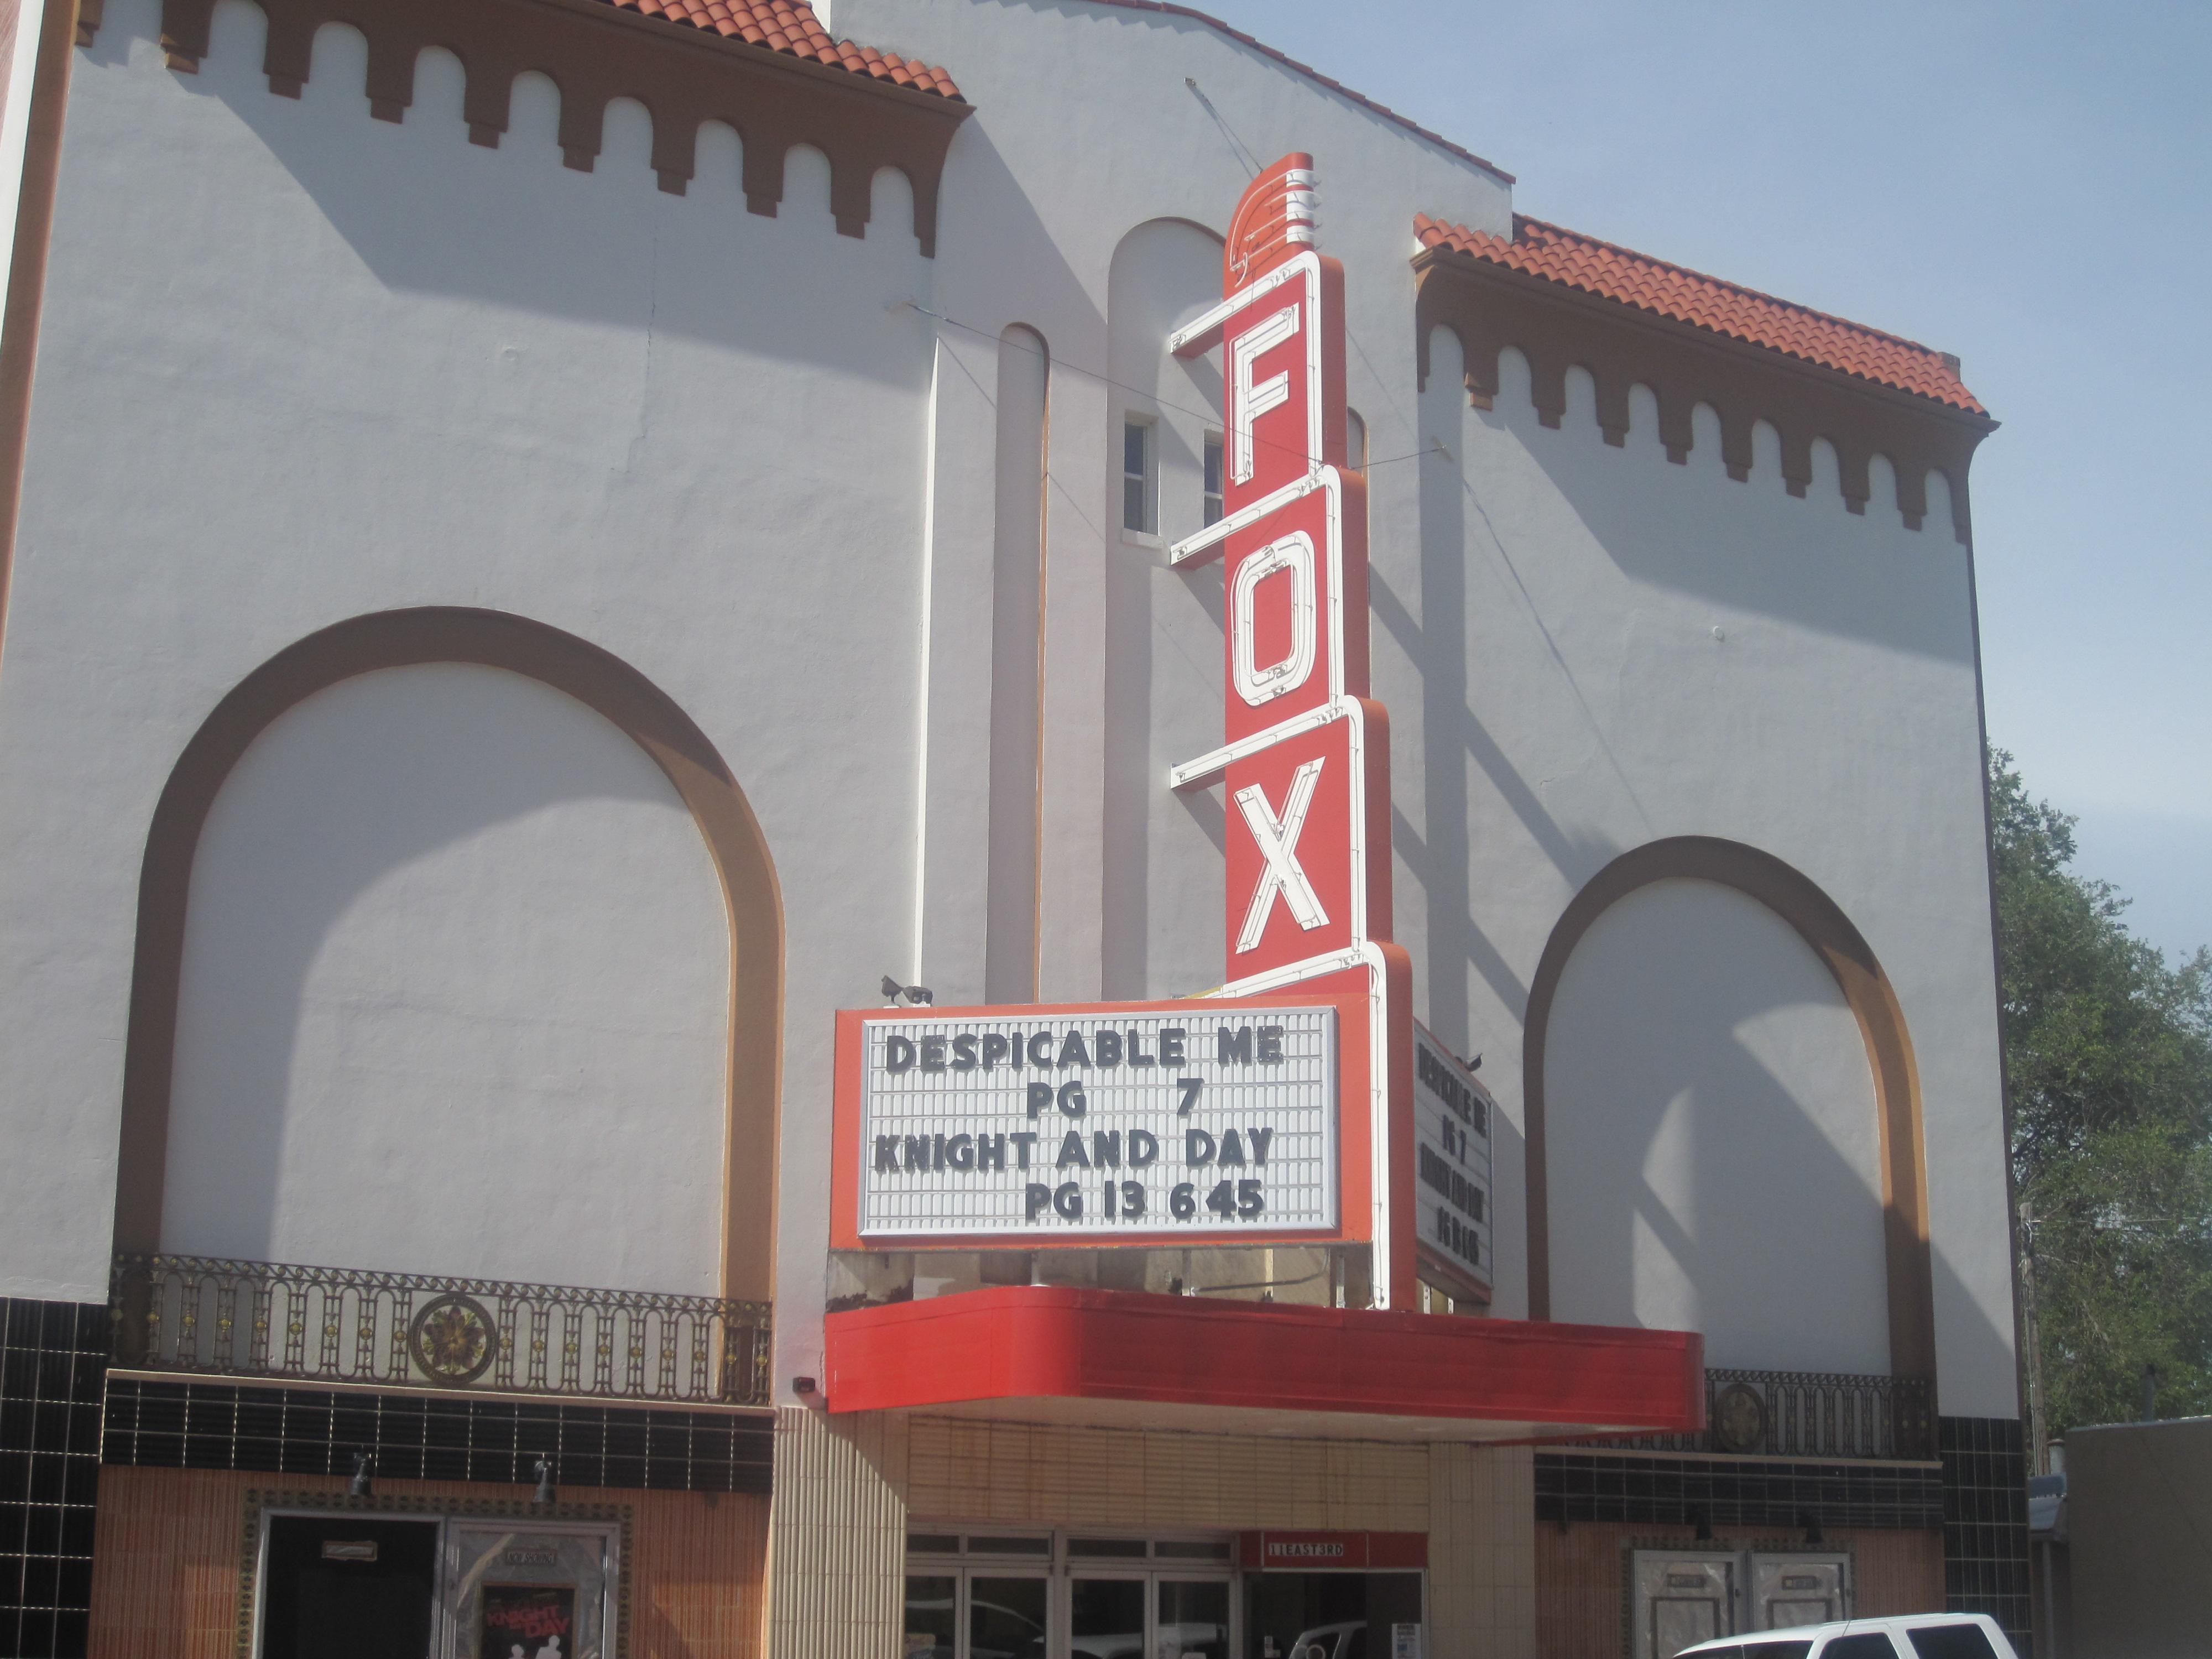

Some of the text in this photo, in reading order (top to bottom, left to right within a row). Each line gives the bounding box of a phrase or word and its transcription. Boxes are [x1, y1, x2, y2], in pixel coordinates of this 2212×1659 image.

[1229, 302, 1331, 954] FOX
[886, 1025, 1284, 1073] DESPICABLE ME
[1027, 1077, 1204, 1119] PG 7
[875, 1126, 1273, 1172] KNIGHT AND DAY
[1025, 1182, 1082, 1221] PG
[1104, 1180, 1145, 1219] 13
[486, 1605, 559, 1627] KNIGHT
[525, 1617, 570, 1638] DAY
